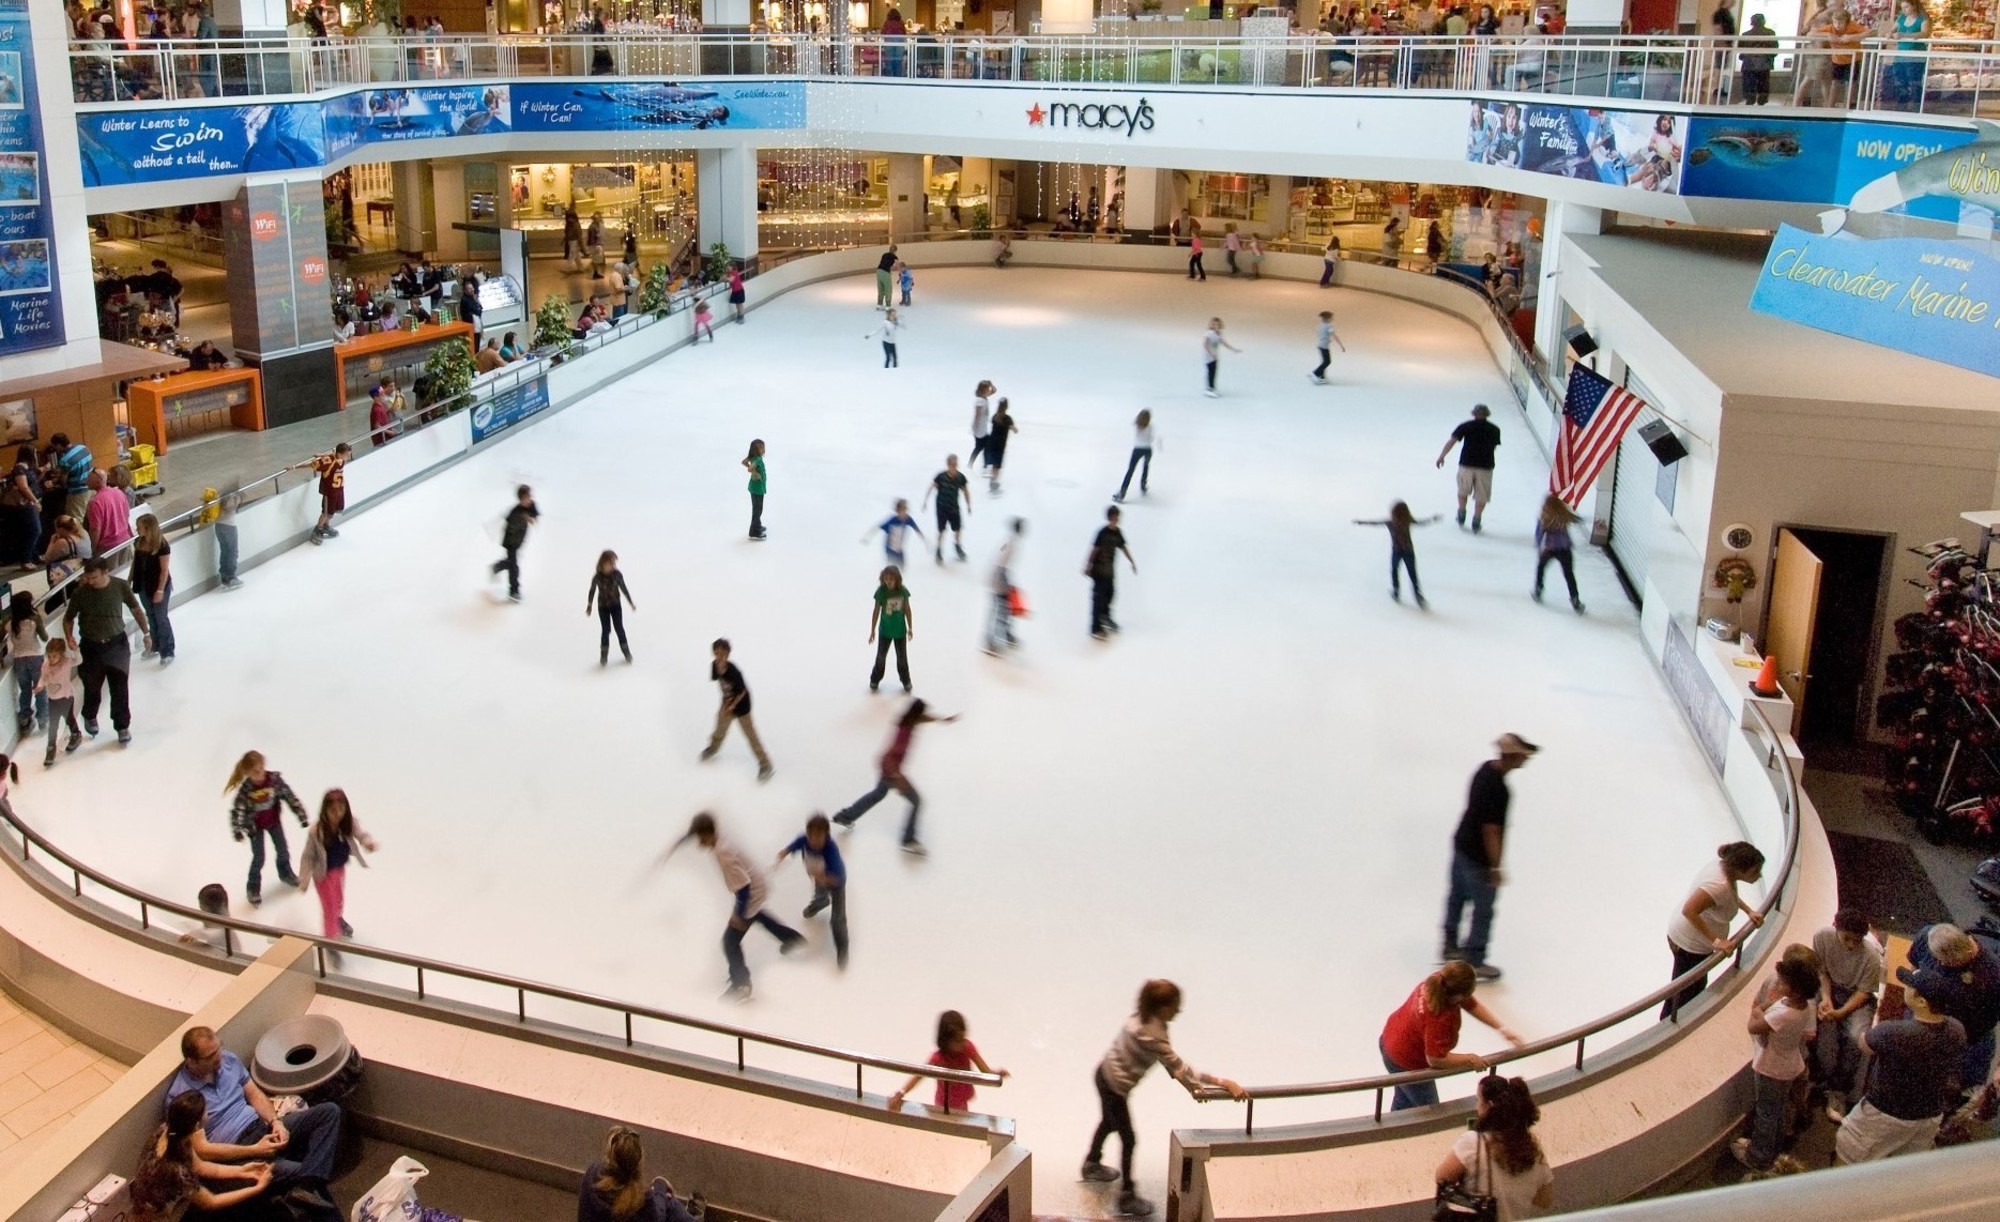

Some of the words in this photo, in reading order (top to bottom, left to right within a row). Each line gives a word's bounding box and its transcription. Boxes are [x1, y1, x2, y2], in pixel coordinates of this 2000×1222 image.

[0, 25, 14, 41] s!
[422, 90, 446, 101] Winter
[449, 89, 475, 100] Inspires
[439, 101, 452, 112] the
[520, 102, 529, 114] If
[531, 101, 558, 112] Winter
[0, 111, 18, 121] ter
[543, 113, 547, 123] I
[550, 113, 572, 123] Can!
[1050, 97, 1155, 137] macy's
[1529, 111, 1565, 131] Winter's
[102, 118, 137, 132] Winter
[140, 118, 175, 130] Learns
[178, 115, 190, 128] to
[150, 122, 224, 151] Swim
[1539, 131, 1571, 155] Family
[1856, 140, 1892, 160] NOW
[133, 152, 174, 169] without
[177, 156, 183, 165] a
[186, 150, 206, 164] tail
[255, 219, 277, 231] WiFi
[305, 263, 324, 275] WiFi
[1770, 241, 1900, 302] Clearwater
[1893, 274, 1989, 323] Marine
[11, 297, 49, 311] Marine
[18, 309, 44, 322] Life
[14, 320, 51, 334] Movies
